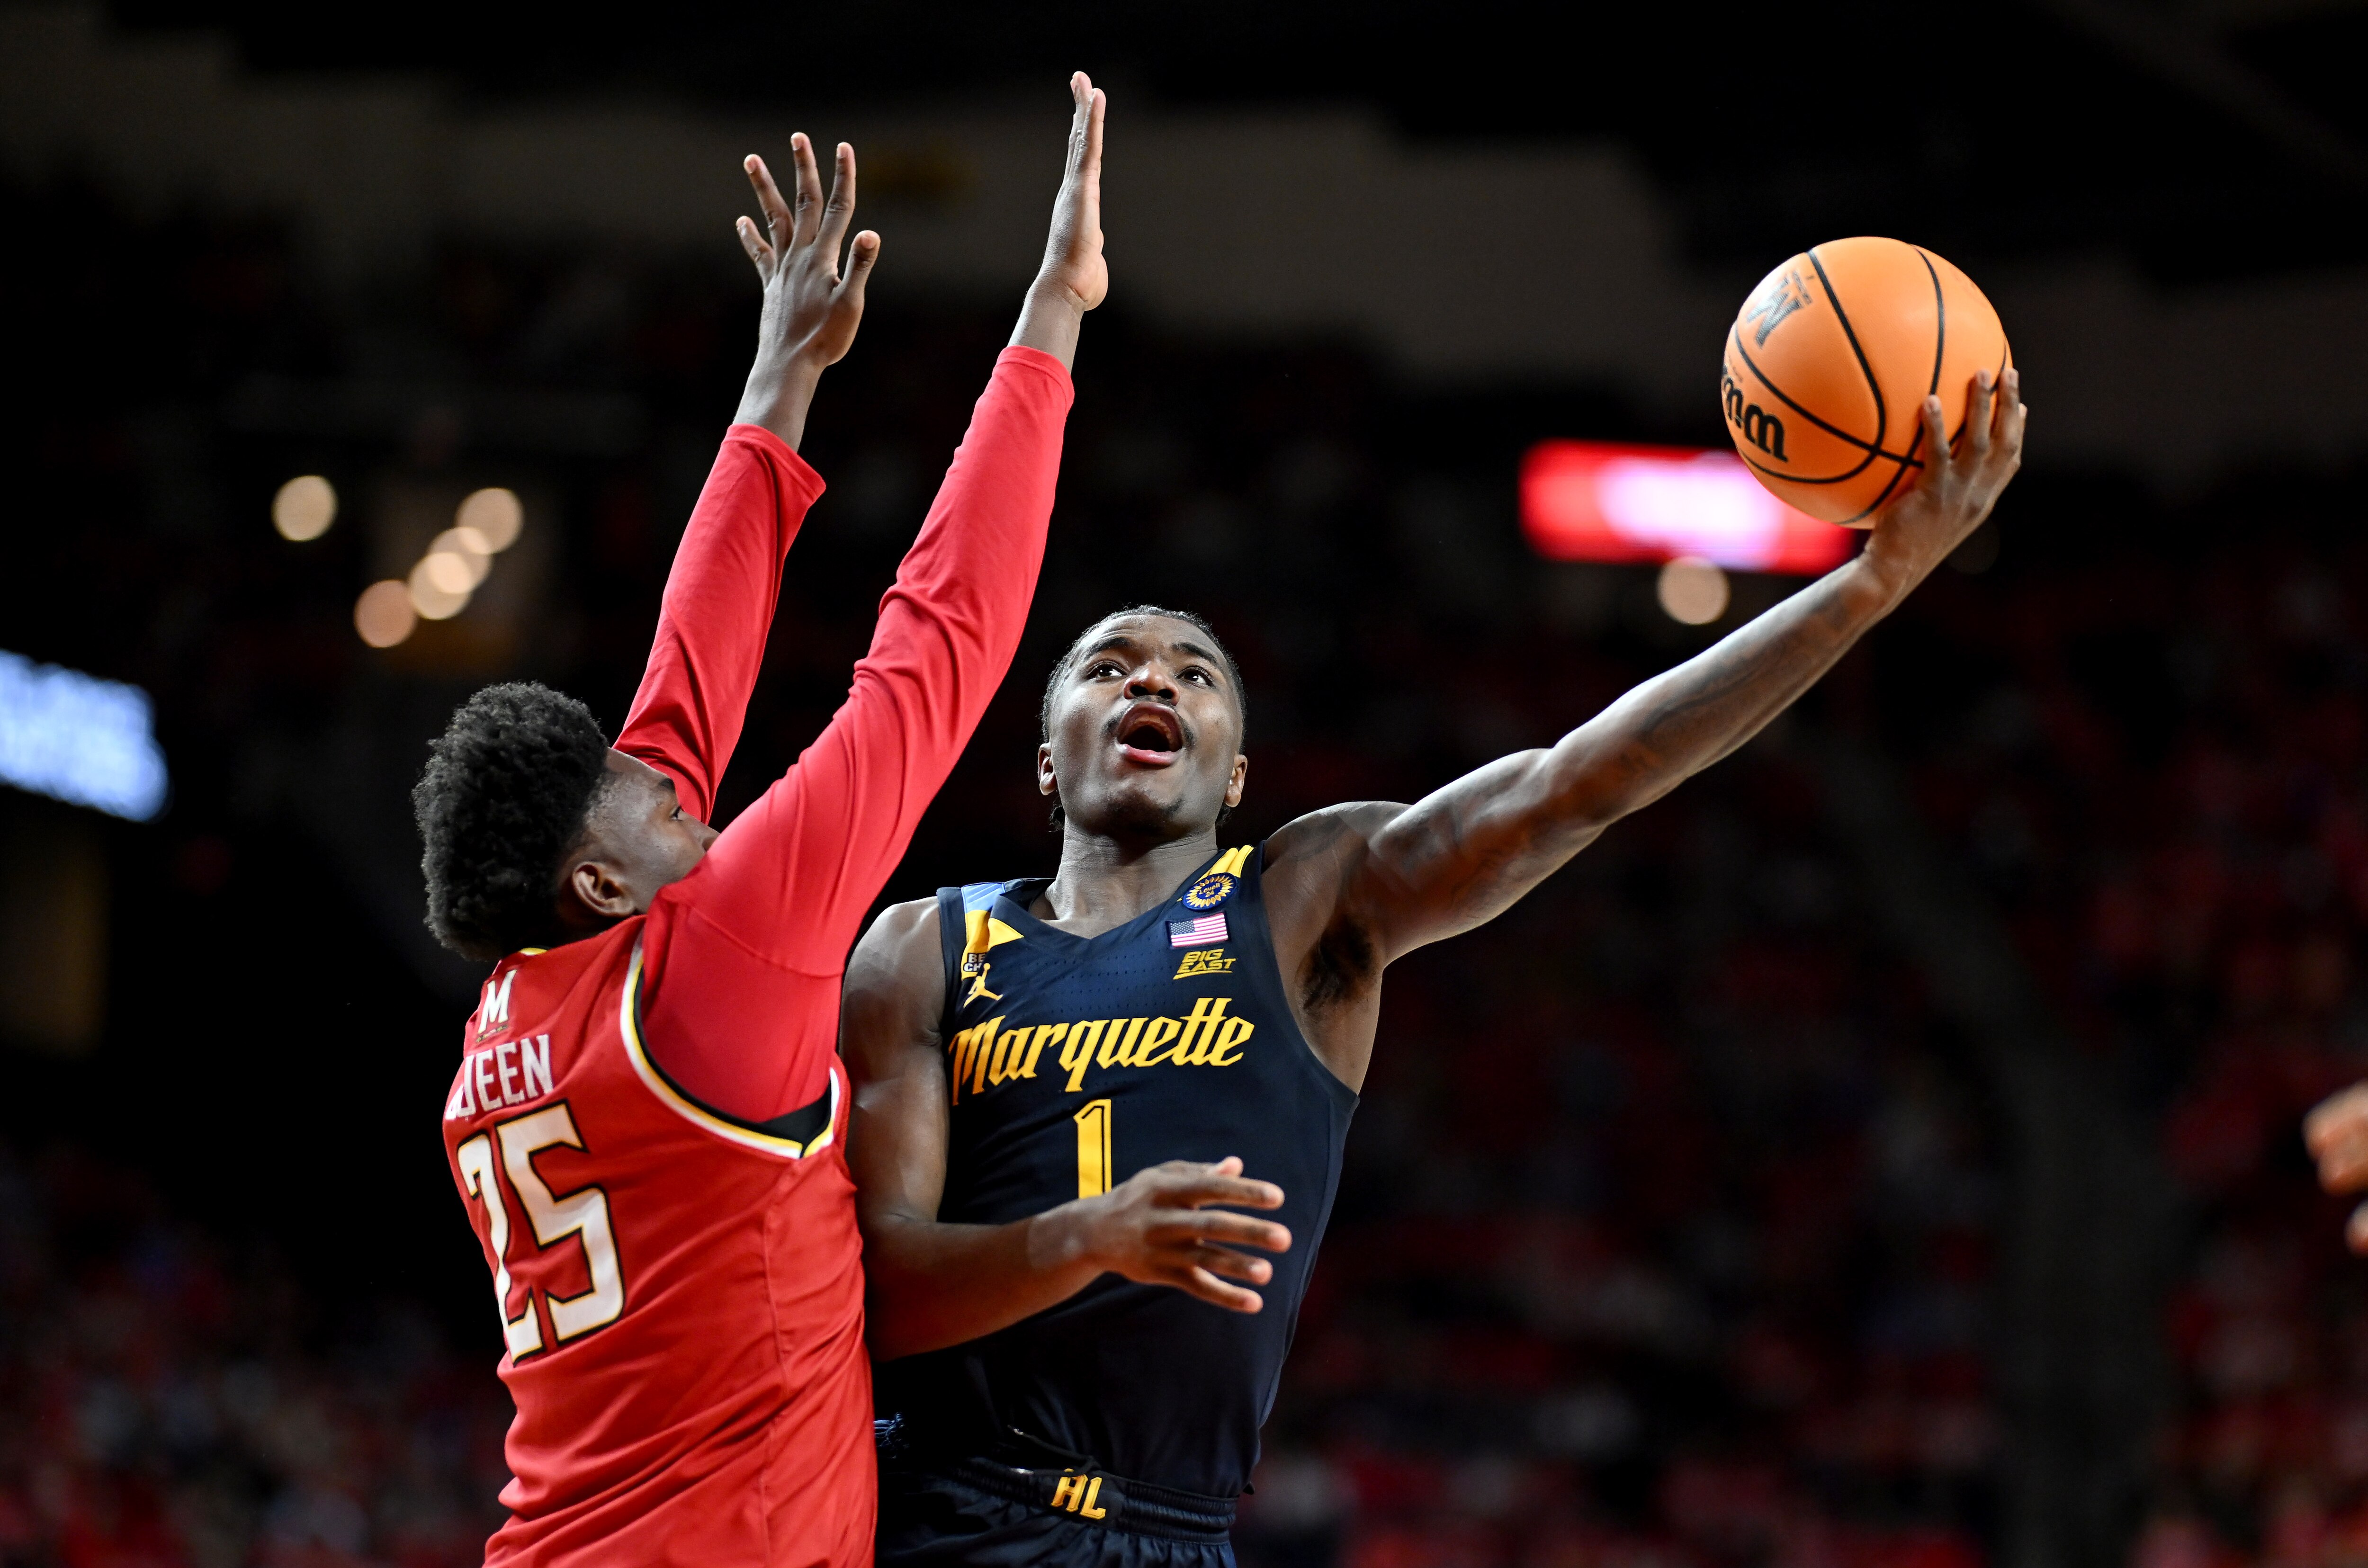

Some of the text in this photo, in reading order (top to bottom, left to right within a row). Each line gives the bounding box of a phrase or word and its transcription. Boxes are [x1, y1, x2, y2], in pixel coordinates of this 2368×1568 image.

[1177, 958, 1236, 974] EAST
[1182, 949, 1224, 963] BIG
[477, 969, 517, 1034] M
[949, 997, 1255, 1106] Marquette
[1073, 1099, 1112, 1200] 1
[457, 1100, 624, 1366] 25
